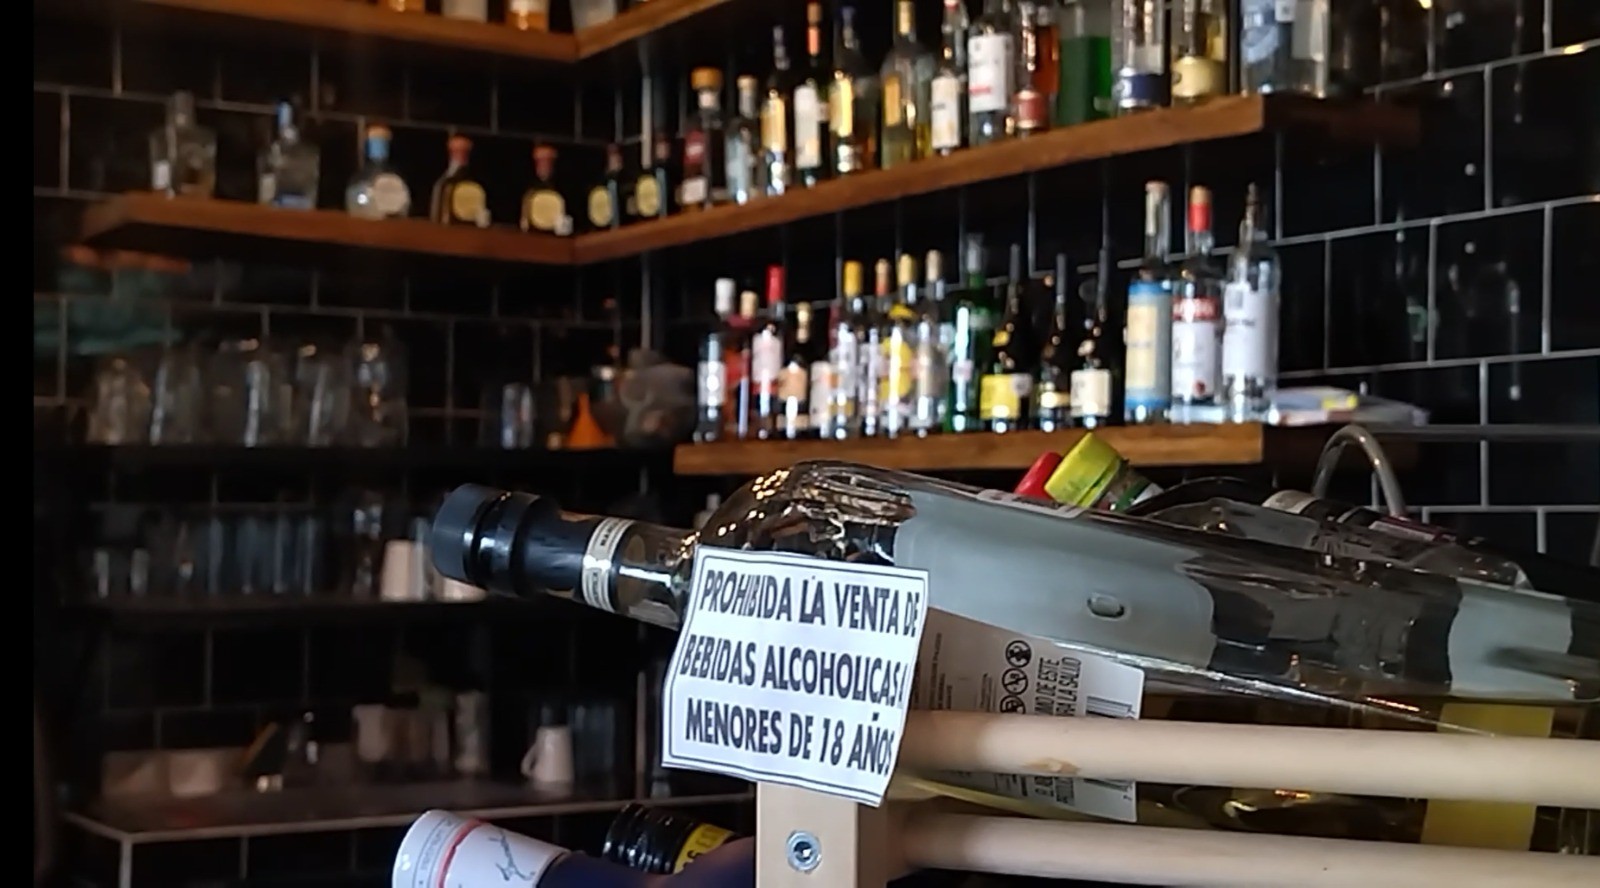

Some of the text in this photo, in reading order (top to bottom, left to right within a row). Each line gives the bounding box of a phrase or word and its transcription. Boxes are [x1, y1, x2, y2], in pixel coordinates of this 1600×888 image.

[699, 569, 920, 638] PROHIBIDA LA VENTA DE
[680, 634, 756, 686] BEBIDAS
[761, 645, 900, 708] ALCOHOLICAS
[685, 698, 895, 777] MENORES DE 18 AÑOS
